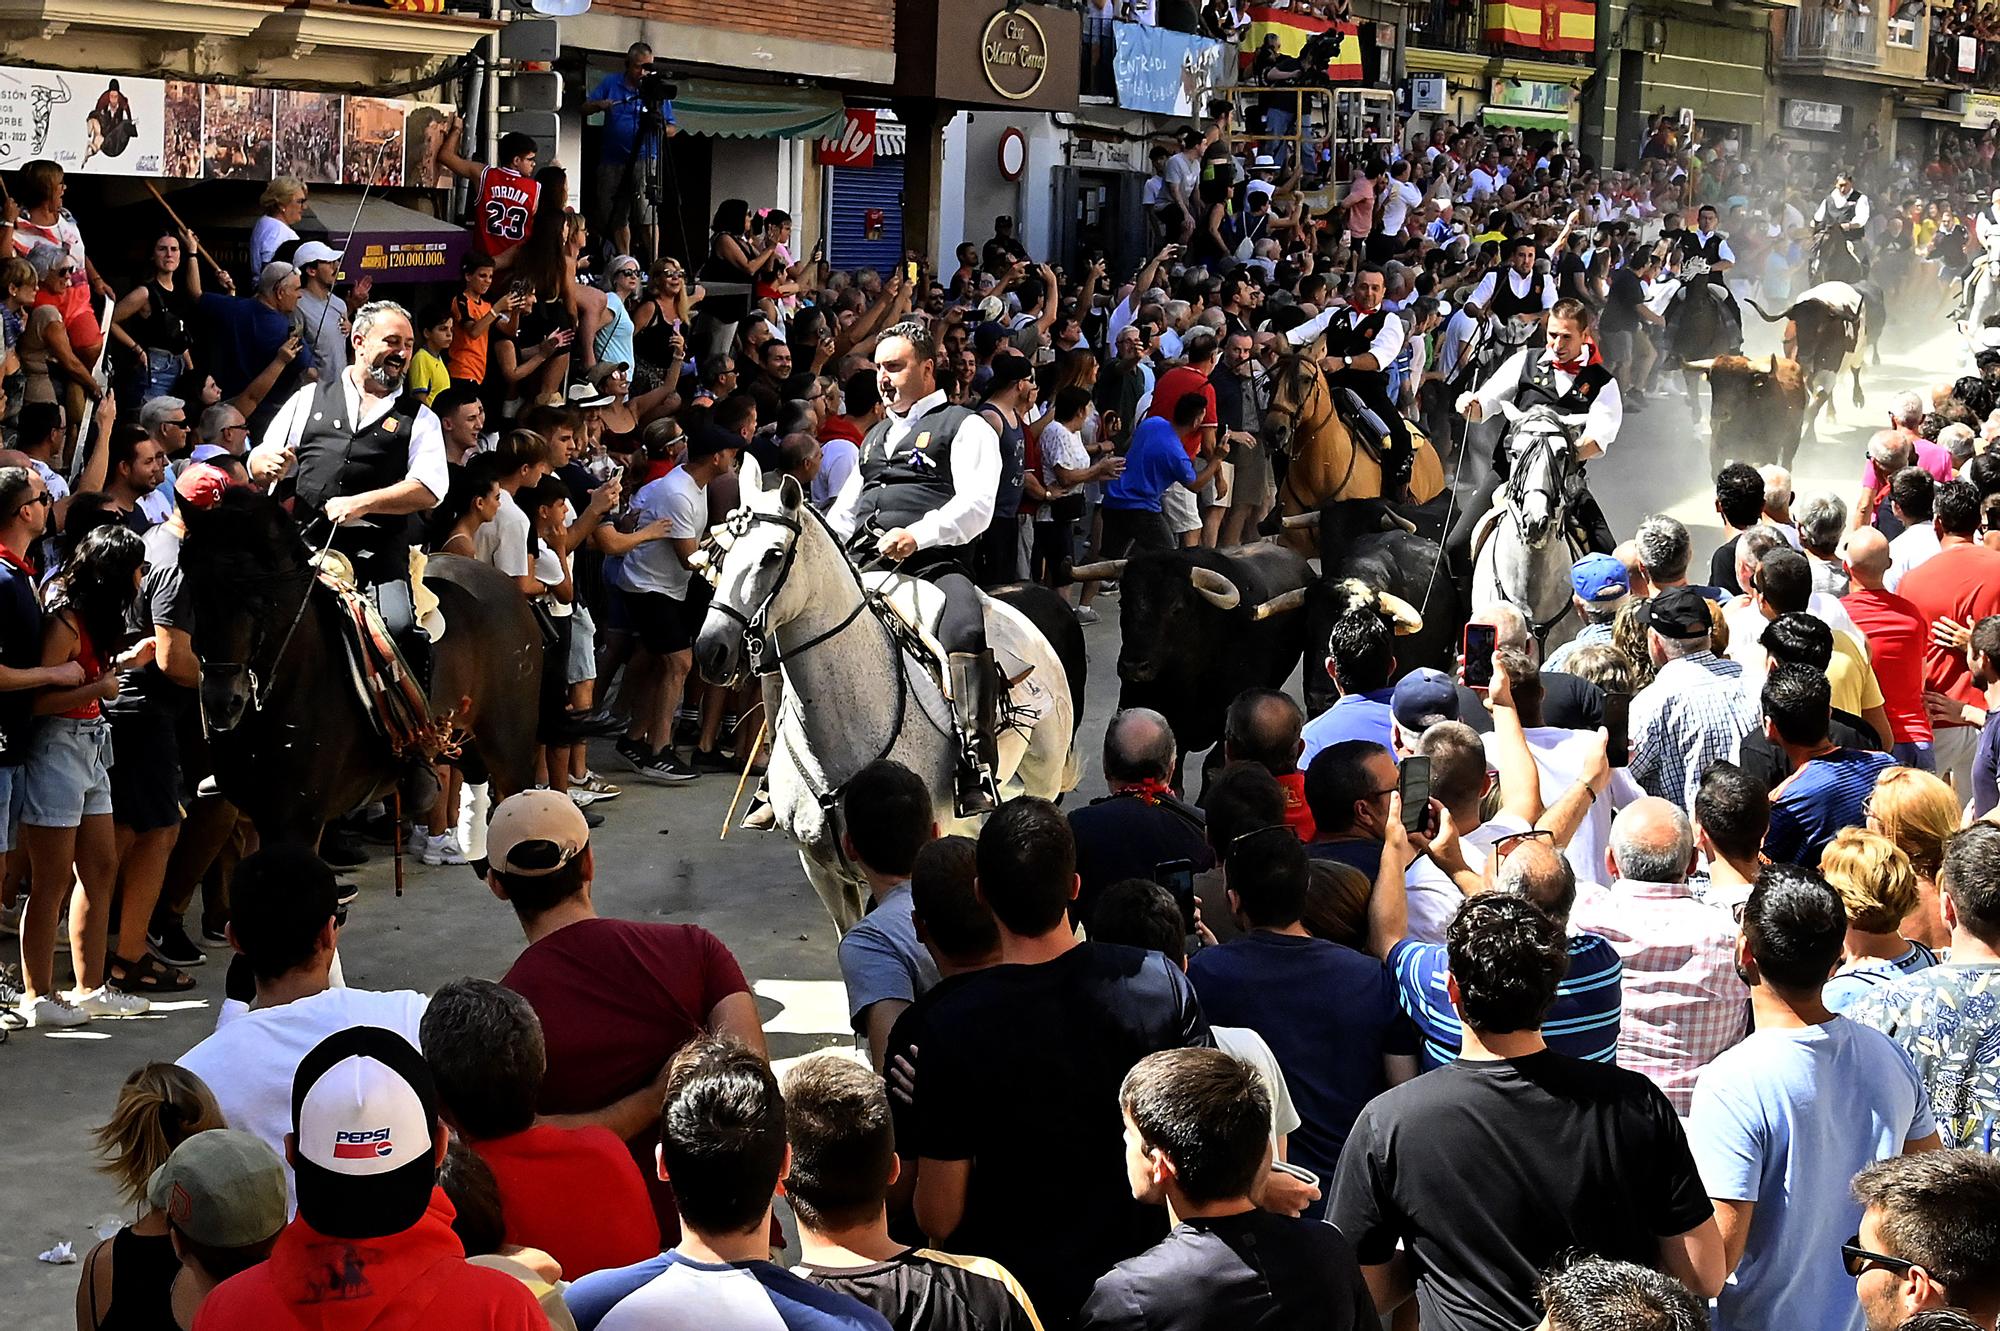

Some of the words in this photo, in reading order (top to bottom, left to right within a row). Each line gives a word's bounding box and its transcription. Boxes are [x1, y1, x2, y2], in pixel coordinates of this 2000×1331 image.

[985, 41, 1017, 66] Mauro
[491, 185, 529, 206] JORDAN
[485, 200, 529, 240] 23
[212, 488, 221, 501] 3
[335, 1128, 390, 1143] PEPSI
